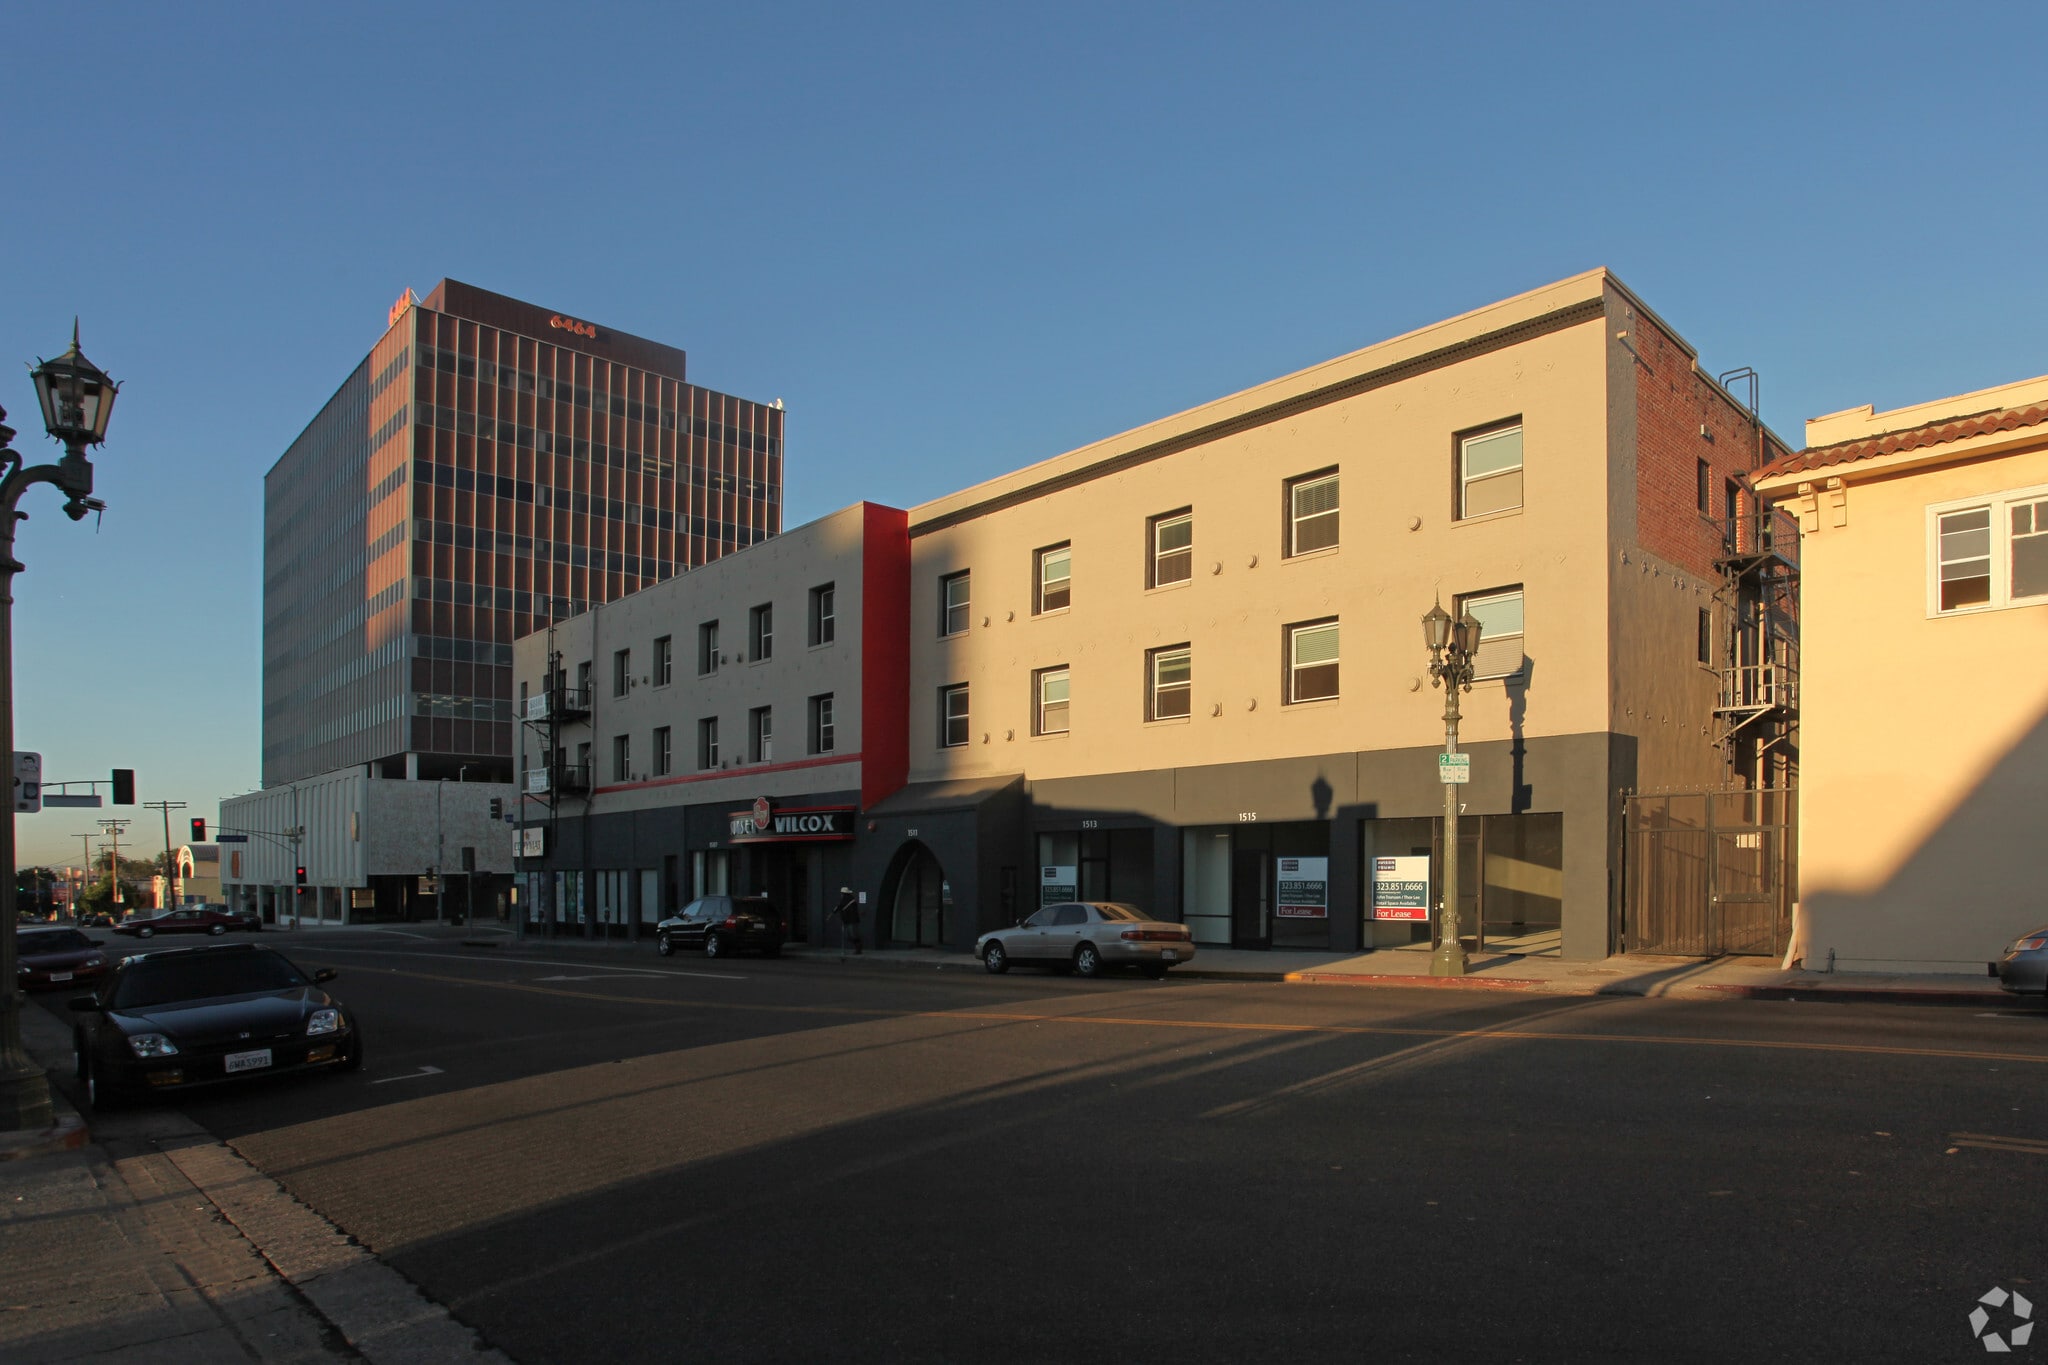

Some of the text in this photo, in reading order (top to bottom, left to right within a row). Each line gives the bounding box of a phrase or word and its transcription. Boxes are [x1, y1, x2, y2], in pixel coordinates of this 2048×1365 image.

[550, 315, 596, 338] 6464
[1441, 755, 1447, 763] 2
[1239, 812, 1257, 822] 1515
[774, 814, 834, 833] WILCOX
[1082, 820, 1098, 829] 1513
[1281, 882, 1323, 890] 323.851.6666
[1376, 882, 1424, 891] 323.851.6666
[1281, 906, 1313, 915] For Lease
[1376, 909, 1412, 918] For Lease
